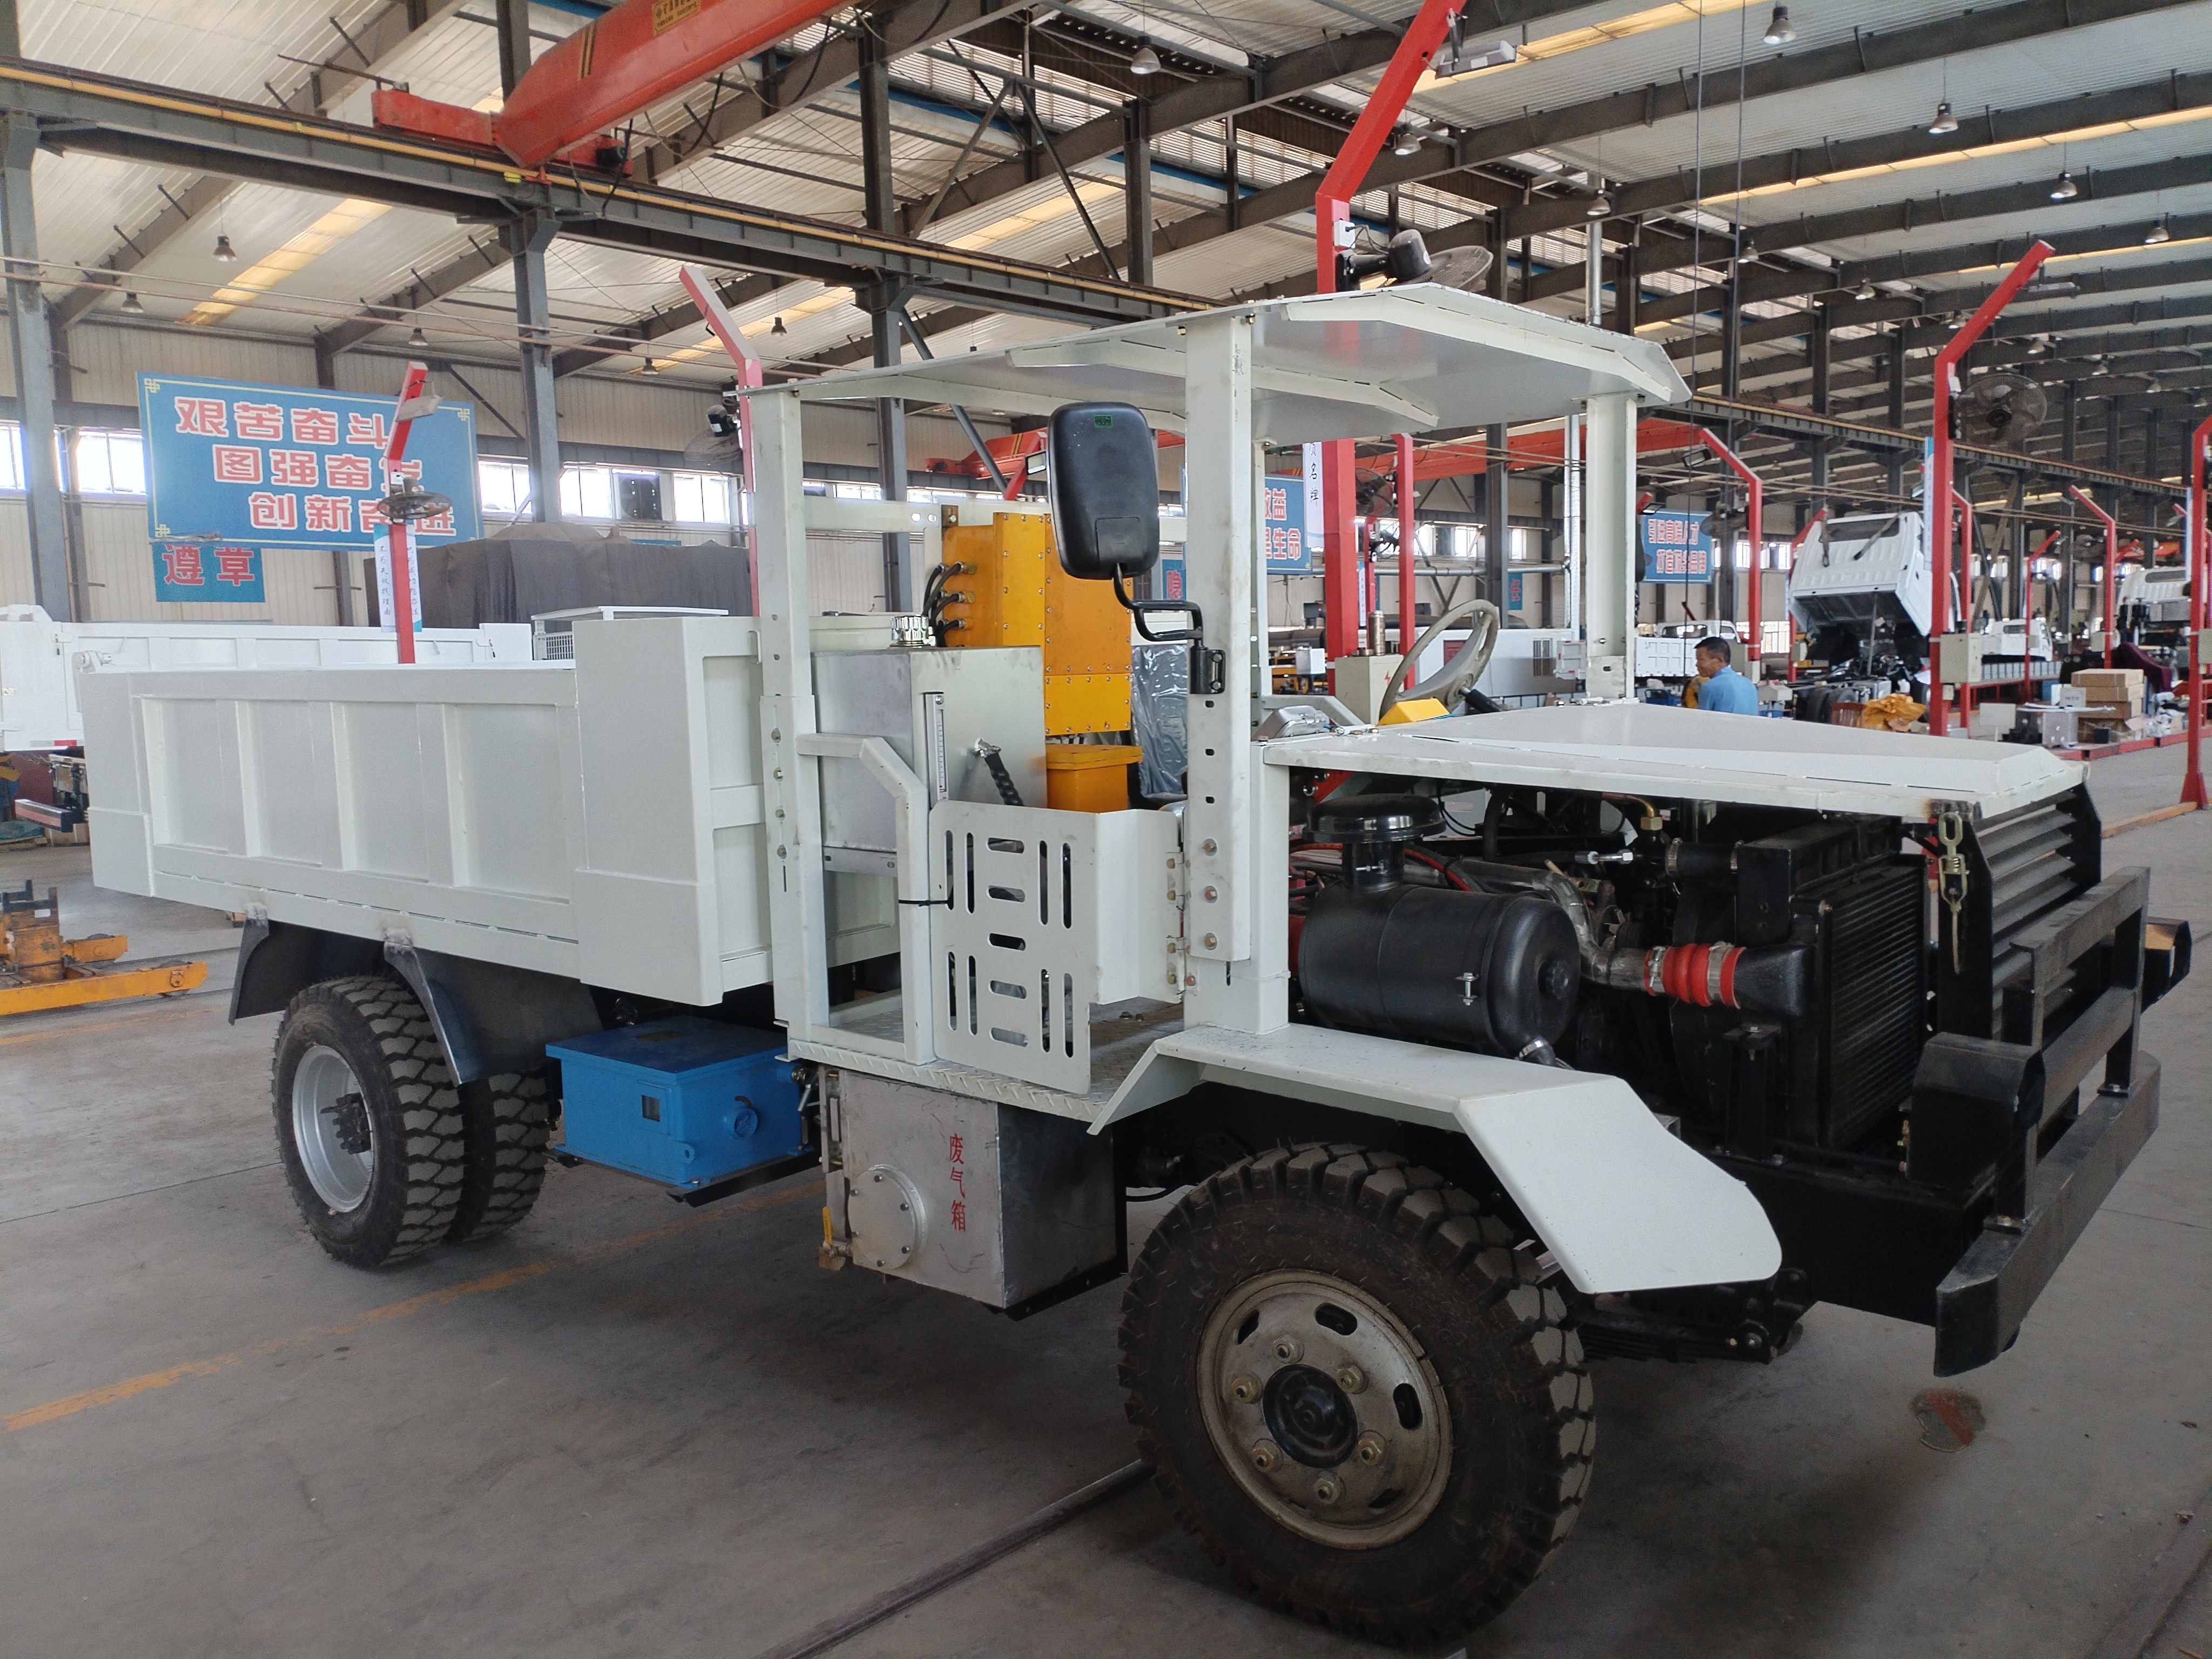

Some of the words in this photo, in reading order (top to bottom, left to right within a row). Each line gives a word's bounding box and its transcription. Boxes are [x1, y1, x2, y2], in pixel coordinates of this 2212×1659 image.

[174, 396, 389, 449] 艰苦奋斗
[949, 1133, 966, 1232] 废气箱
